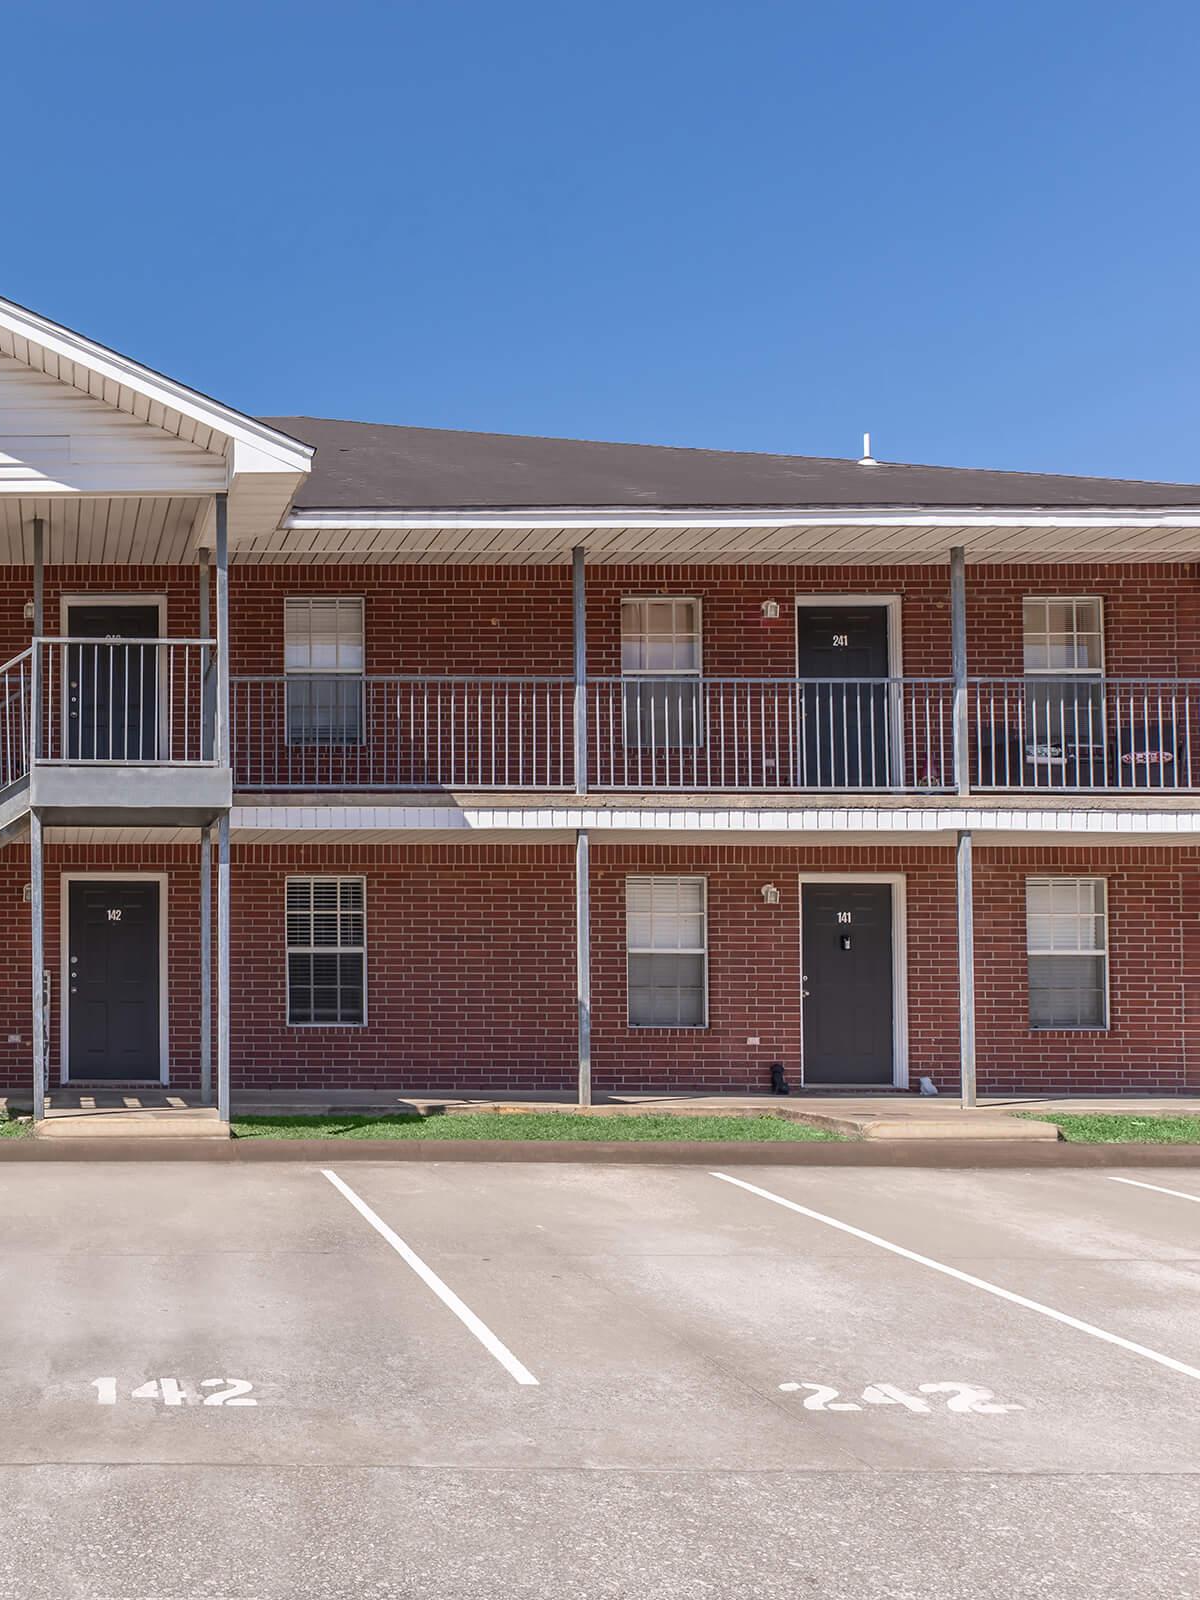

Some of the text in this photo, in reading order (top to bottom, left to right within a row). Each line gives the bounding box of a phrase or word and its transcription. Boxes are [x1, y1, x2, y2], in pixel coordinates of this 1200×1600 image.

[832, 634, 848, 647] 241
[107, 909, 122, 921] 142
[836, 911, 852, 924] 141
[90, 1376, 258, 1406] 142
[778, 1381, 1024, 1414] 242
